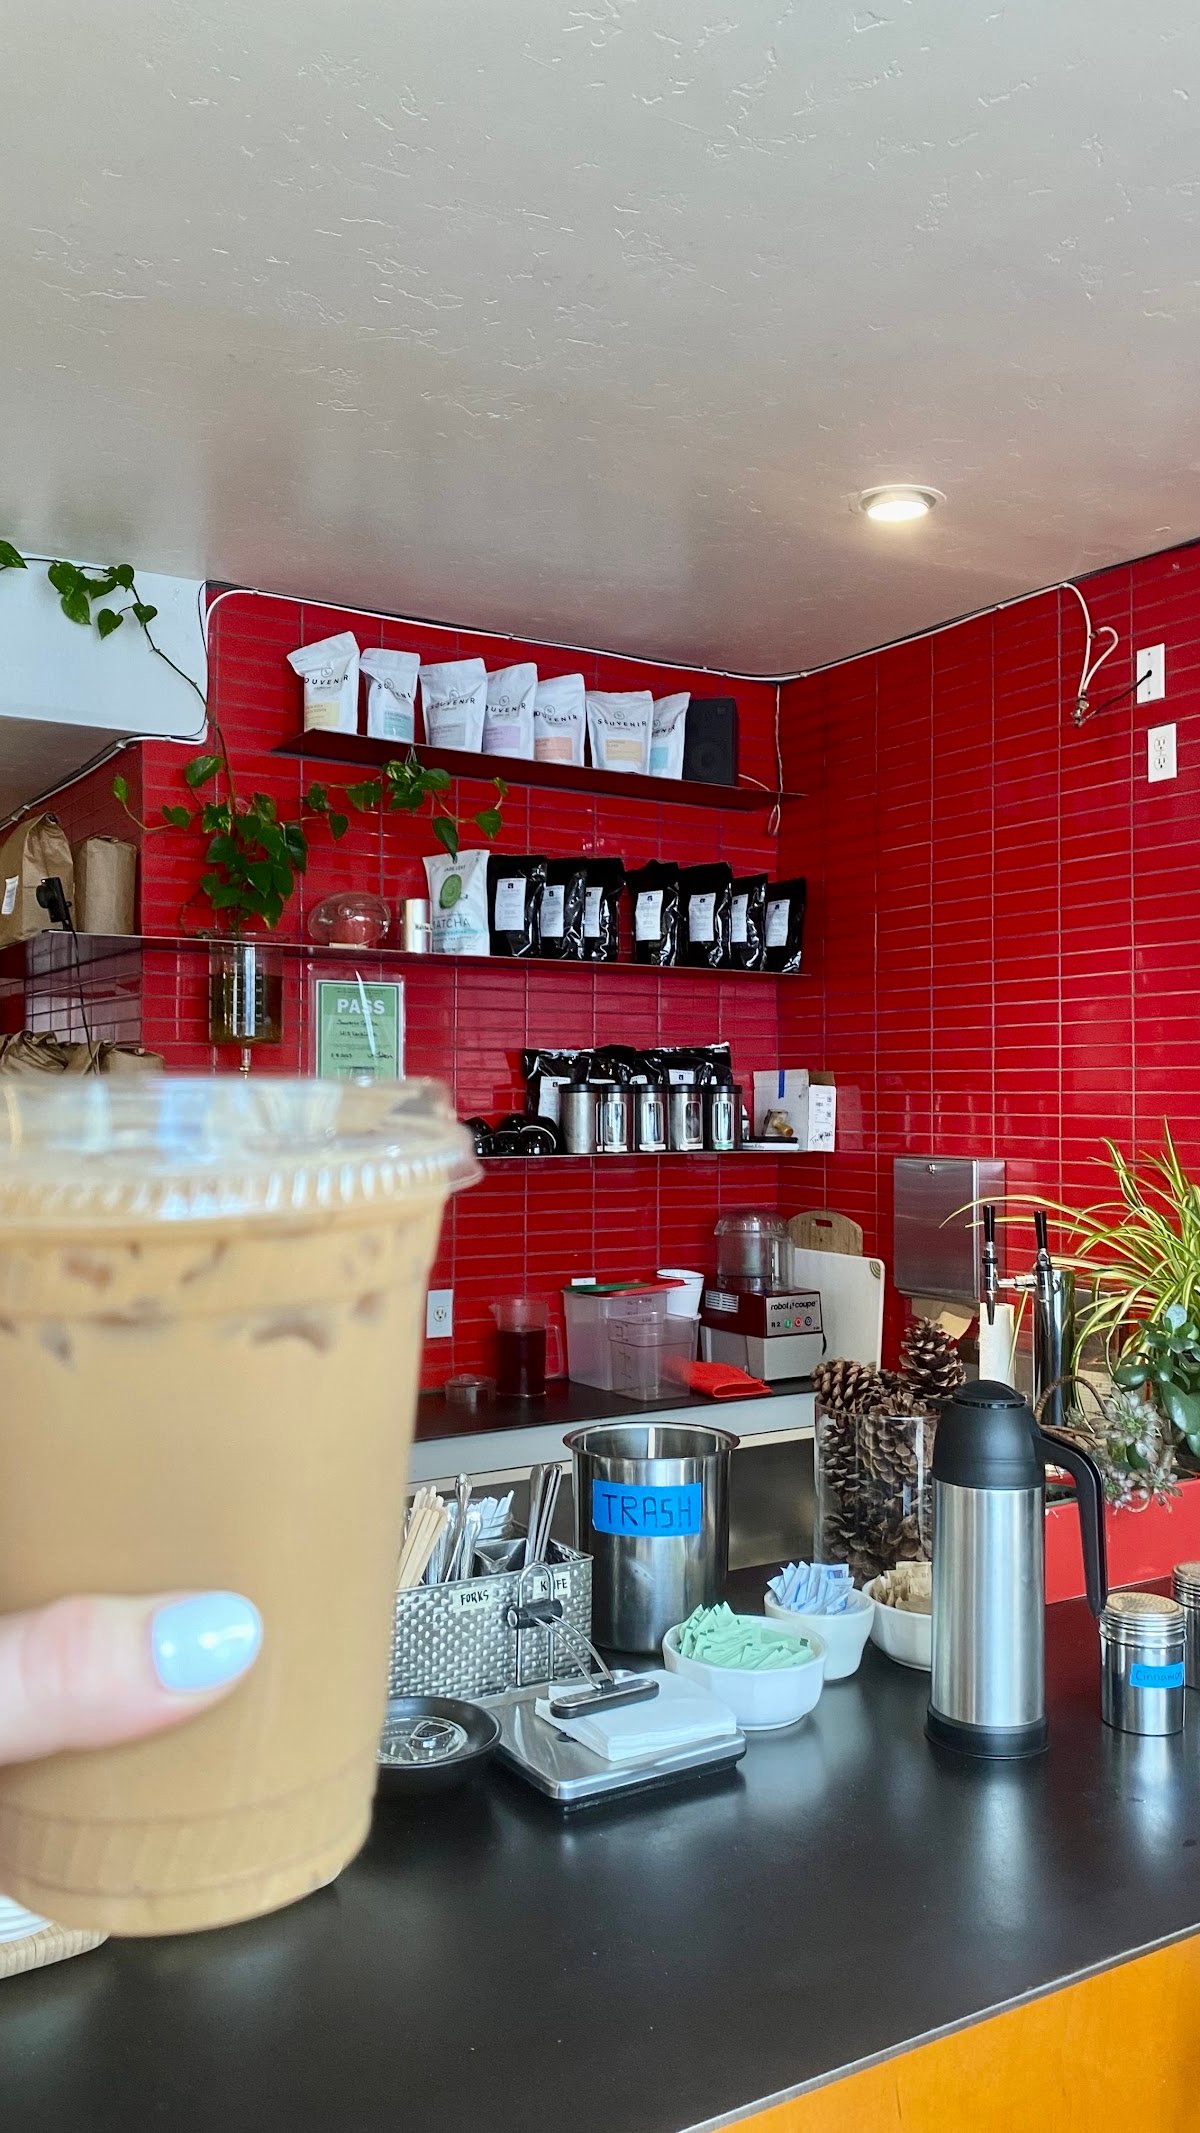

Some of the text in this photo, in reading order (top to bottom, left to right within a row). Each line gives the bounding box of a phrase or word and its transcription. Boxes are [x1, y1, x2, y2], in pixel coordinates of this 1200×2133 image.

[304, 674, 349, 685] OUVENIR
[336, 998, 386, 1015] PASS
[601, 1492, 692, 1529] TRASH
[460, 1589, 489, 1606] FORKS
